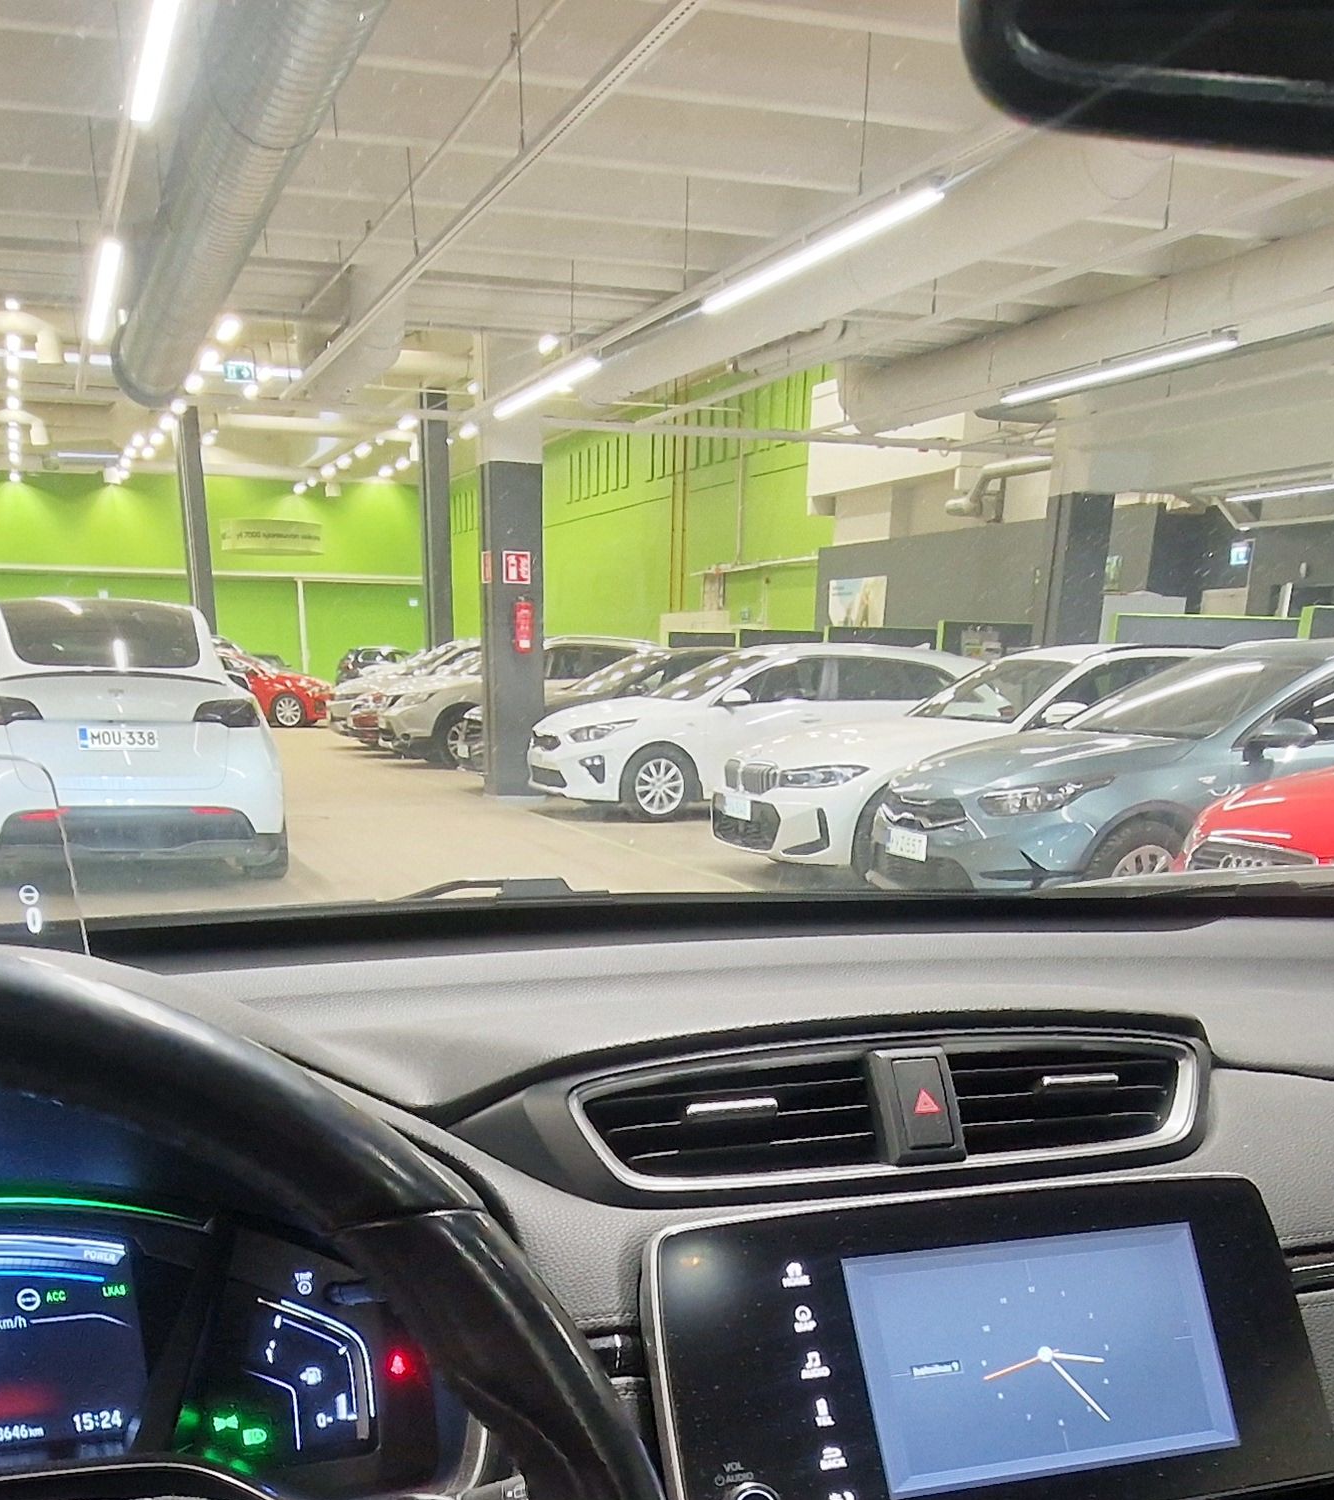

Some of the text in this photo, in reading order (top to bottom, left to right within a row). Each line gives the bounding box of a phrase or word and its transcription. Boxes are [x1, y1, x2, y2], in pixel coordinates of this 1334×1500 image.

[90, 730, 156, 746] MOU-338
[82, 1249, 118, 1263] POWER
[46, 1291, 67, 1303] ACC
[101, 1284, 127, 1298] LKAS
[72, 1410, 123, 1432] 15:24
[722, 1461, 745, 1473] VOL
[725, 1471, 755, 1484] AUDIO
